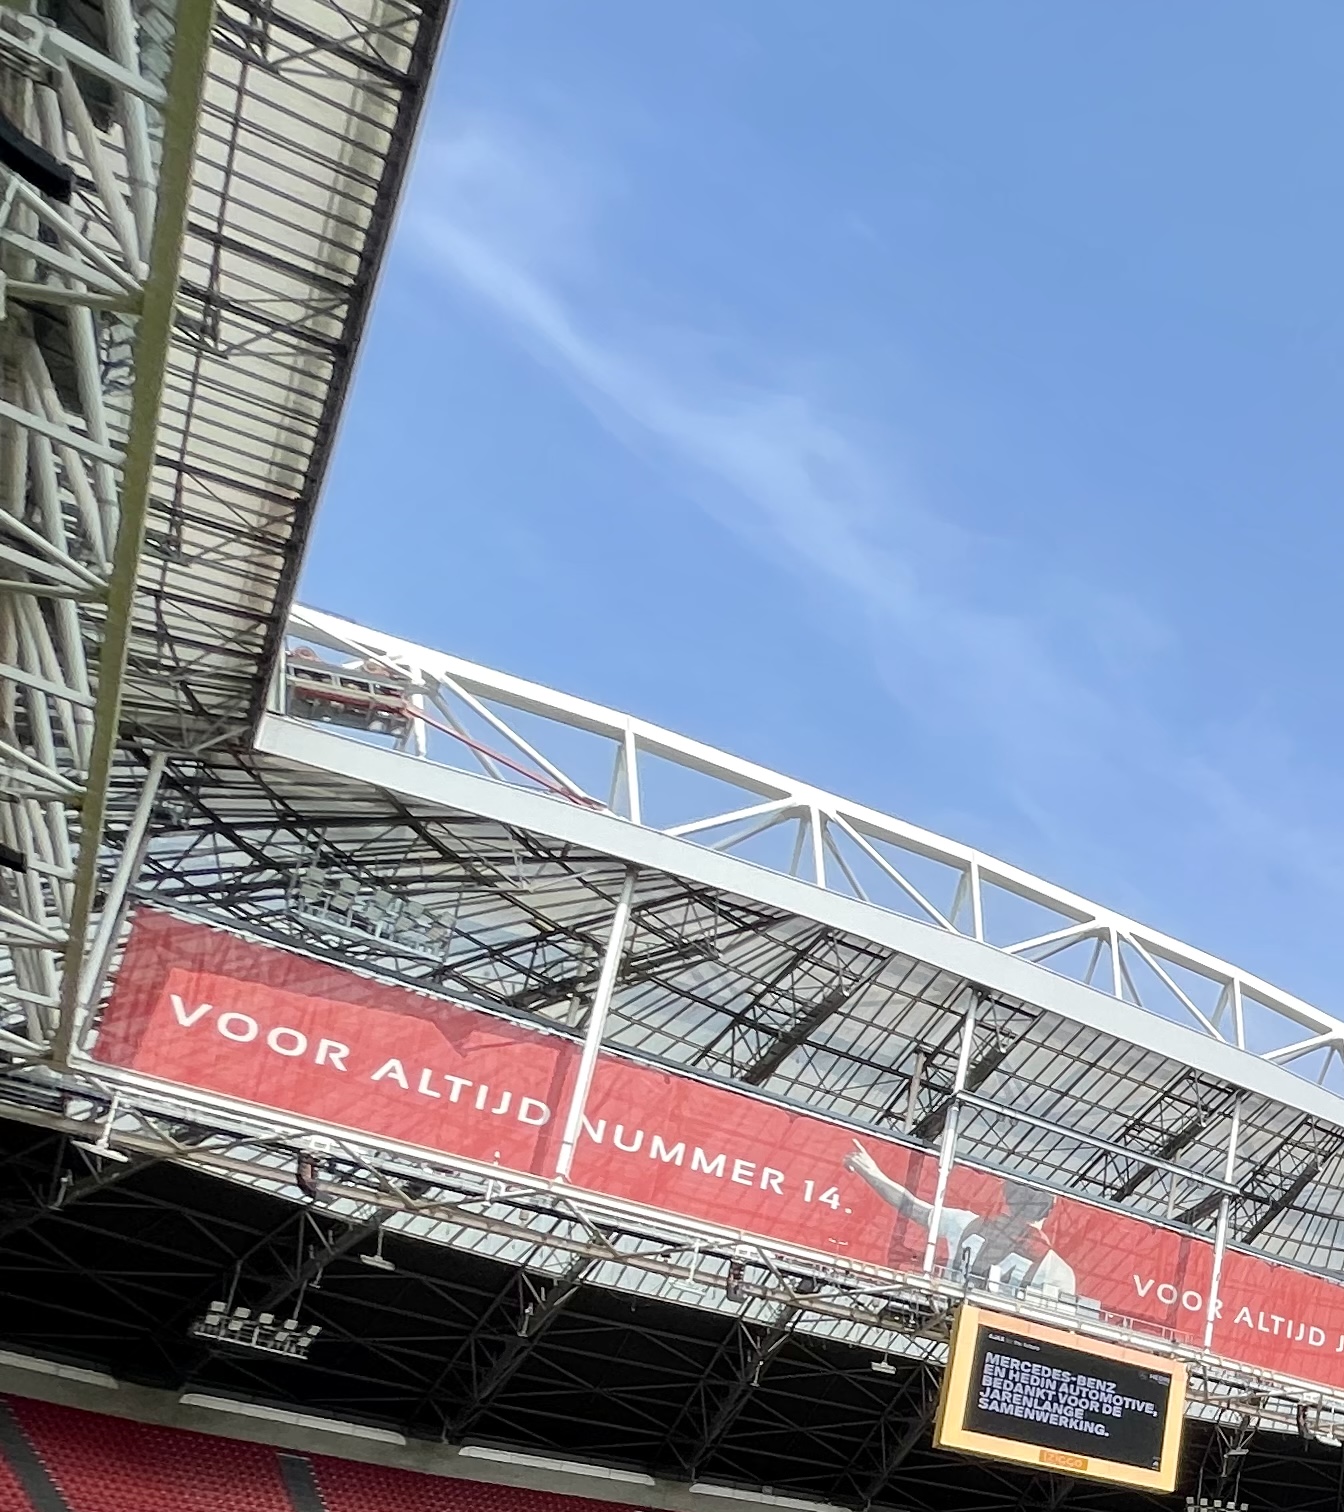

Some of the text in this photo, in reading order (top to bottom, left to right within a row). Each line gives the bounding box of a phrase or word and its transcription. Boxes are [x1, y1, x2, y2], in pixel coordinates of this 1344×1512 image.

[170, 993, 853, 1214] VOOR ALTIJD NUMMER 14.
[1133, 1275, 1223, 1319] VOOR
[1234, 1306, 1326, 1347] ALTIJD
[983, 1364, 1158, 1417] EN HEDIN AUTOMOTIVE,
[985, 1351, 1117, 1395] MERCEDES-BENZ
[977, 1398, 1110, 1437] SAMENWERKING.
[979, 1388, 1085, 1419] JARENLANGE
[981, 1376, 1122, 1418] BEDANKT VOOR DE
